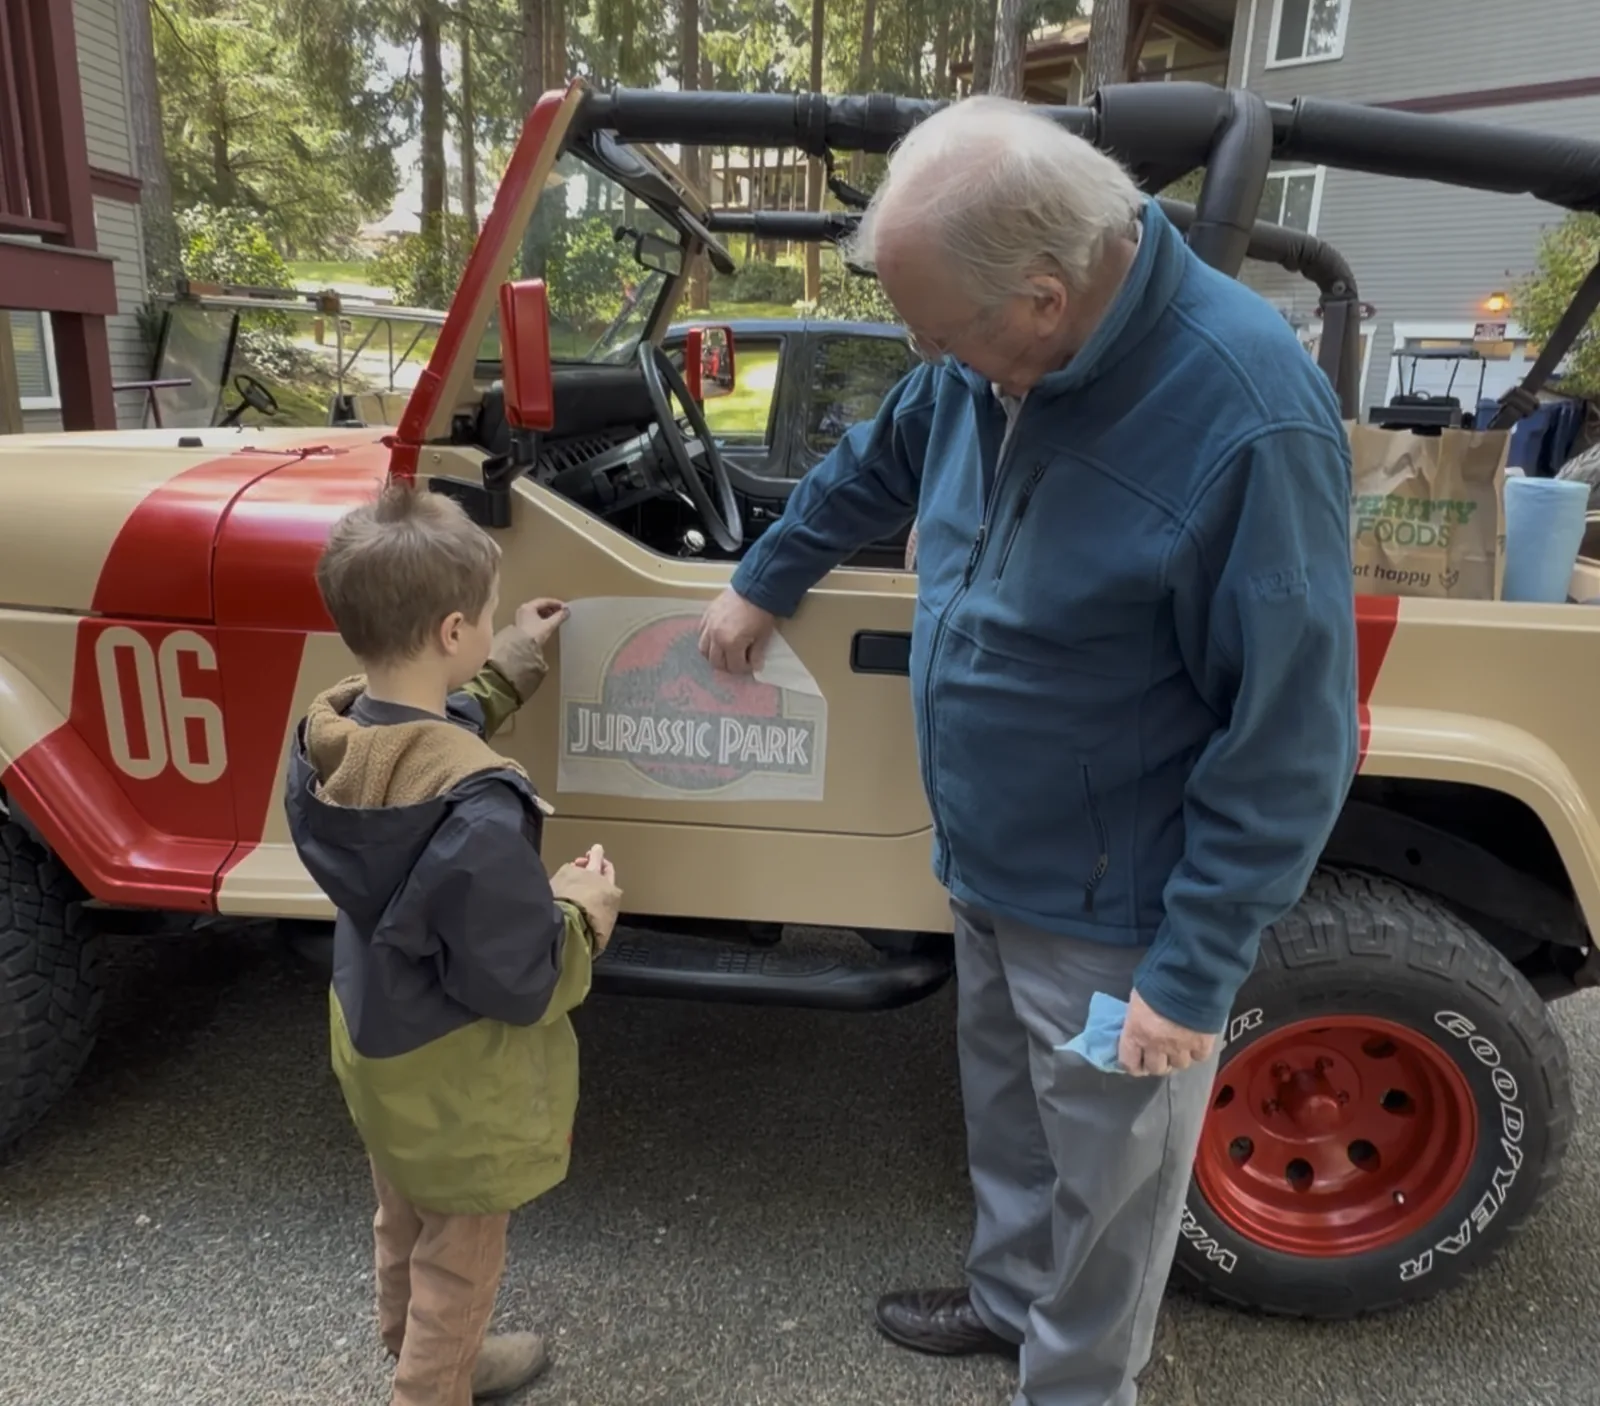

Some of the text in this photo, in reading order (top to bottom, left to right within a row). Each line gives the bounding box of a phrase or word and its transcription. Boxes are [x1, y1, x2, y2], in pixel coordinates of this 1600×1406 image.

[1355, 517, 1450, 548] FOODS
[1352, 564, 1431, 587] at happy
[95, 626, 228, 784] 06
[570, 707, 809, 765] JURASSIC PARK
[1400, 1010, 1524, 1281] GOODYEAR
